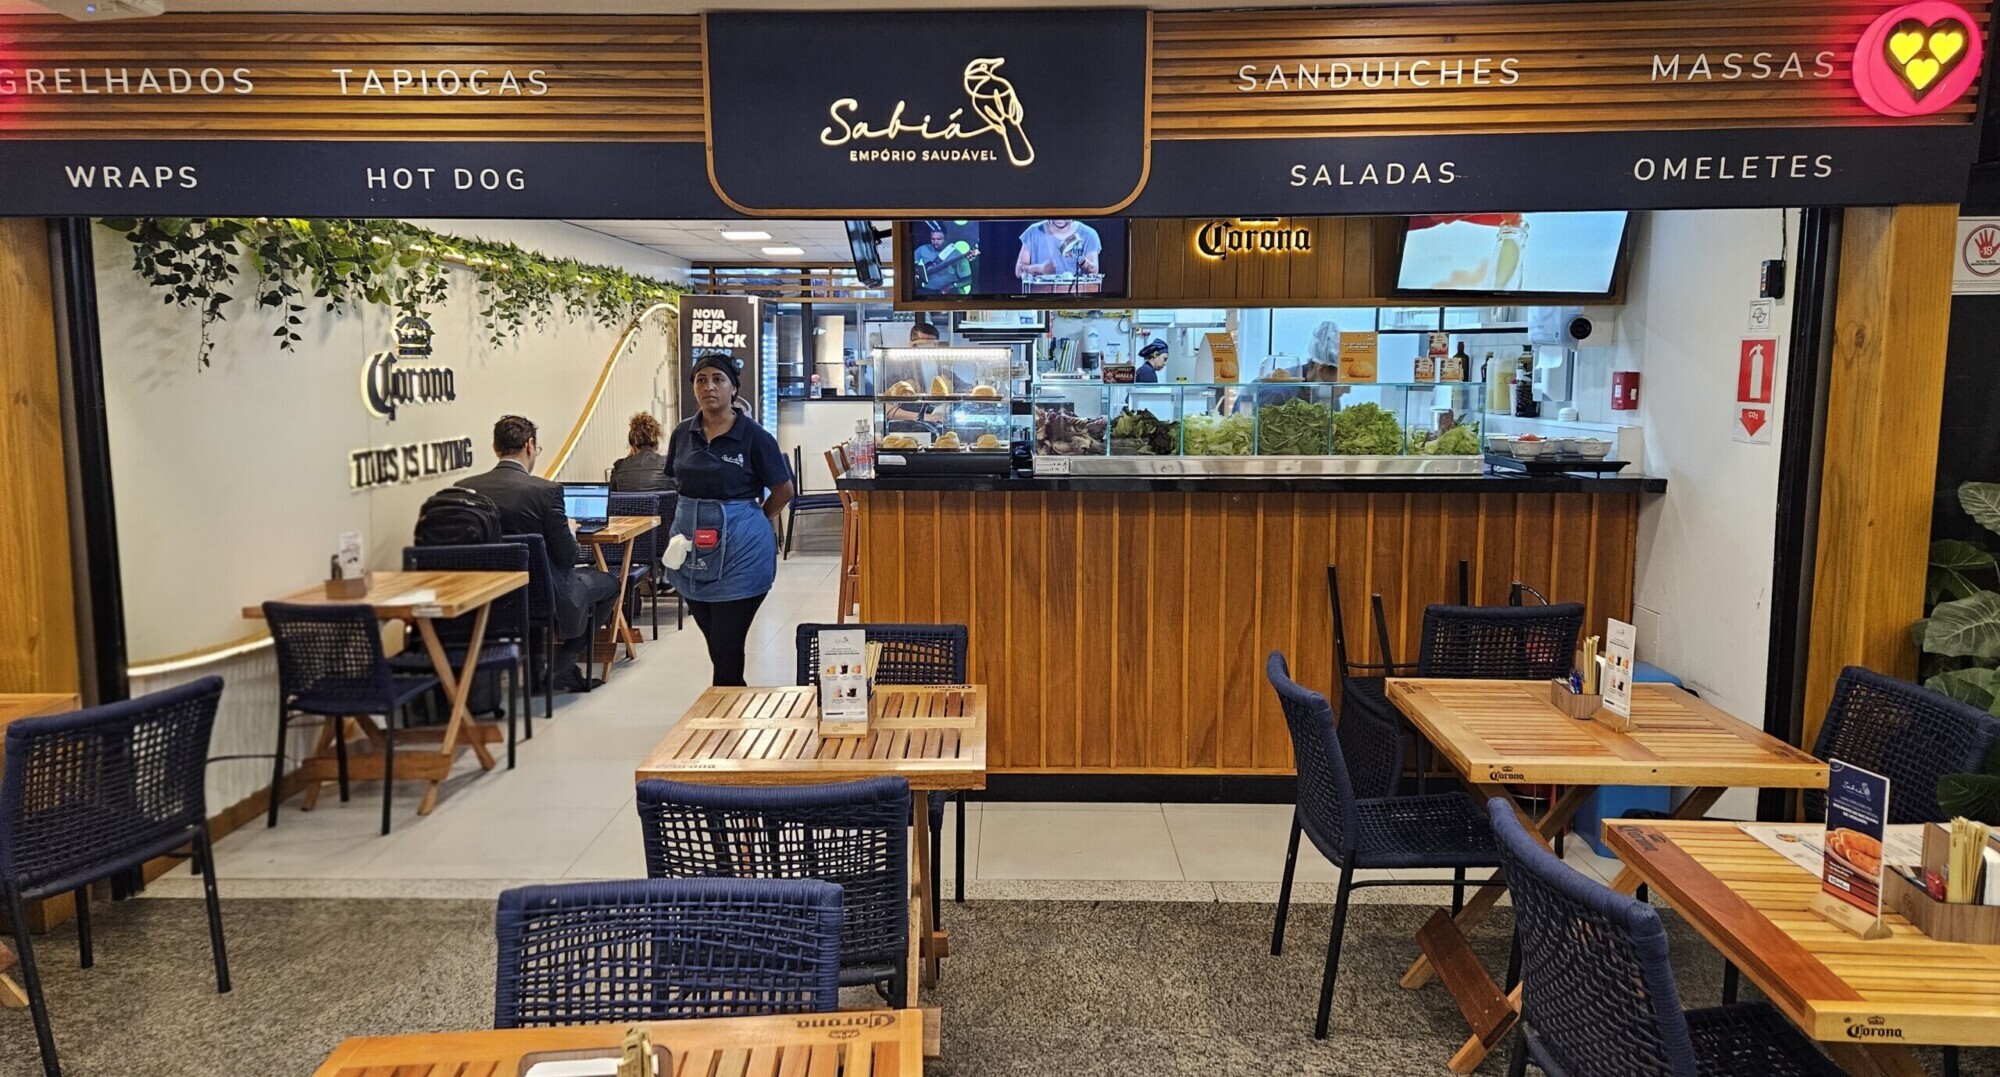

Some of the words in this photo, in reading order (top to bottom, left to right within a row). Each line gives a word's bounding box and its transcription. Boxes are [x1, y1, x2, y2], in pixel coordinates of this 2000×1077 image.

[1237, 58, 1520, 91] SANDUICHES
[1651, 51, 1836, 82] MASSAS
[0, 68, 254, 95] GRELHADOS
[332, 68, 549, 96] TAPIOCAS
[820, 98, 976, 146] Sabiá
[850, 148, 917, 162] EMPÓRIO
[921, 148, 998, 161] SAUDÁVEL
[64, 165, 199, 189] WRAPS
[366, 168, 436, 190] HOT
[453, 168, 525, 190] DOG
[1290, 161, 1457, 187] SALADAS
[1633, 155, 1833, 182] OMELETES
[1198, 220, 1312, 261] Corona
[691, 319, 739, 334] PEPSI
[692, 308, 726, 320] NOVA
[691, 333, 748, 349] BLACK
[363, 351, 456, 421] Corona
[1489, 771, 1526, 782] Corona
[1846, 1024, 1904, 1040] Corona
